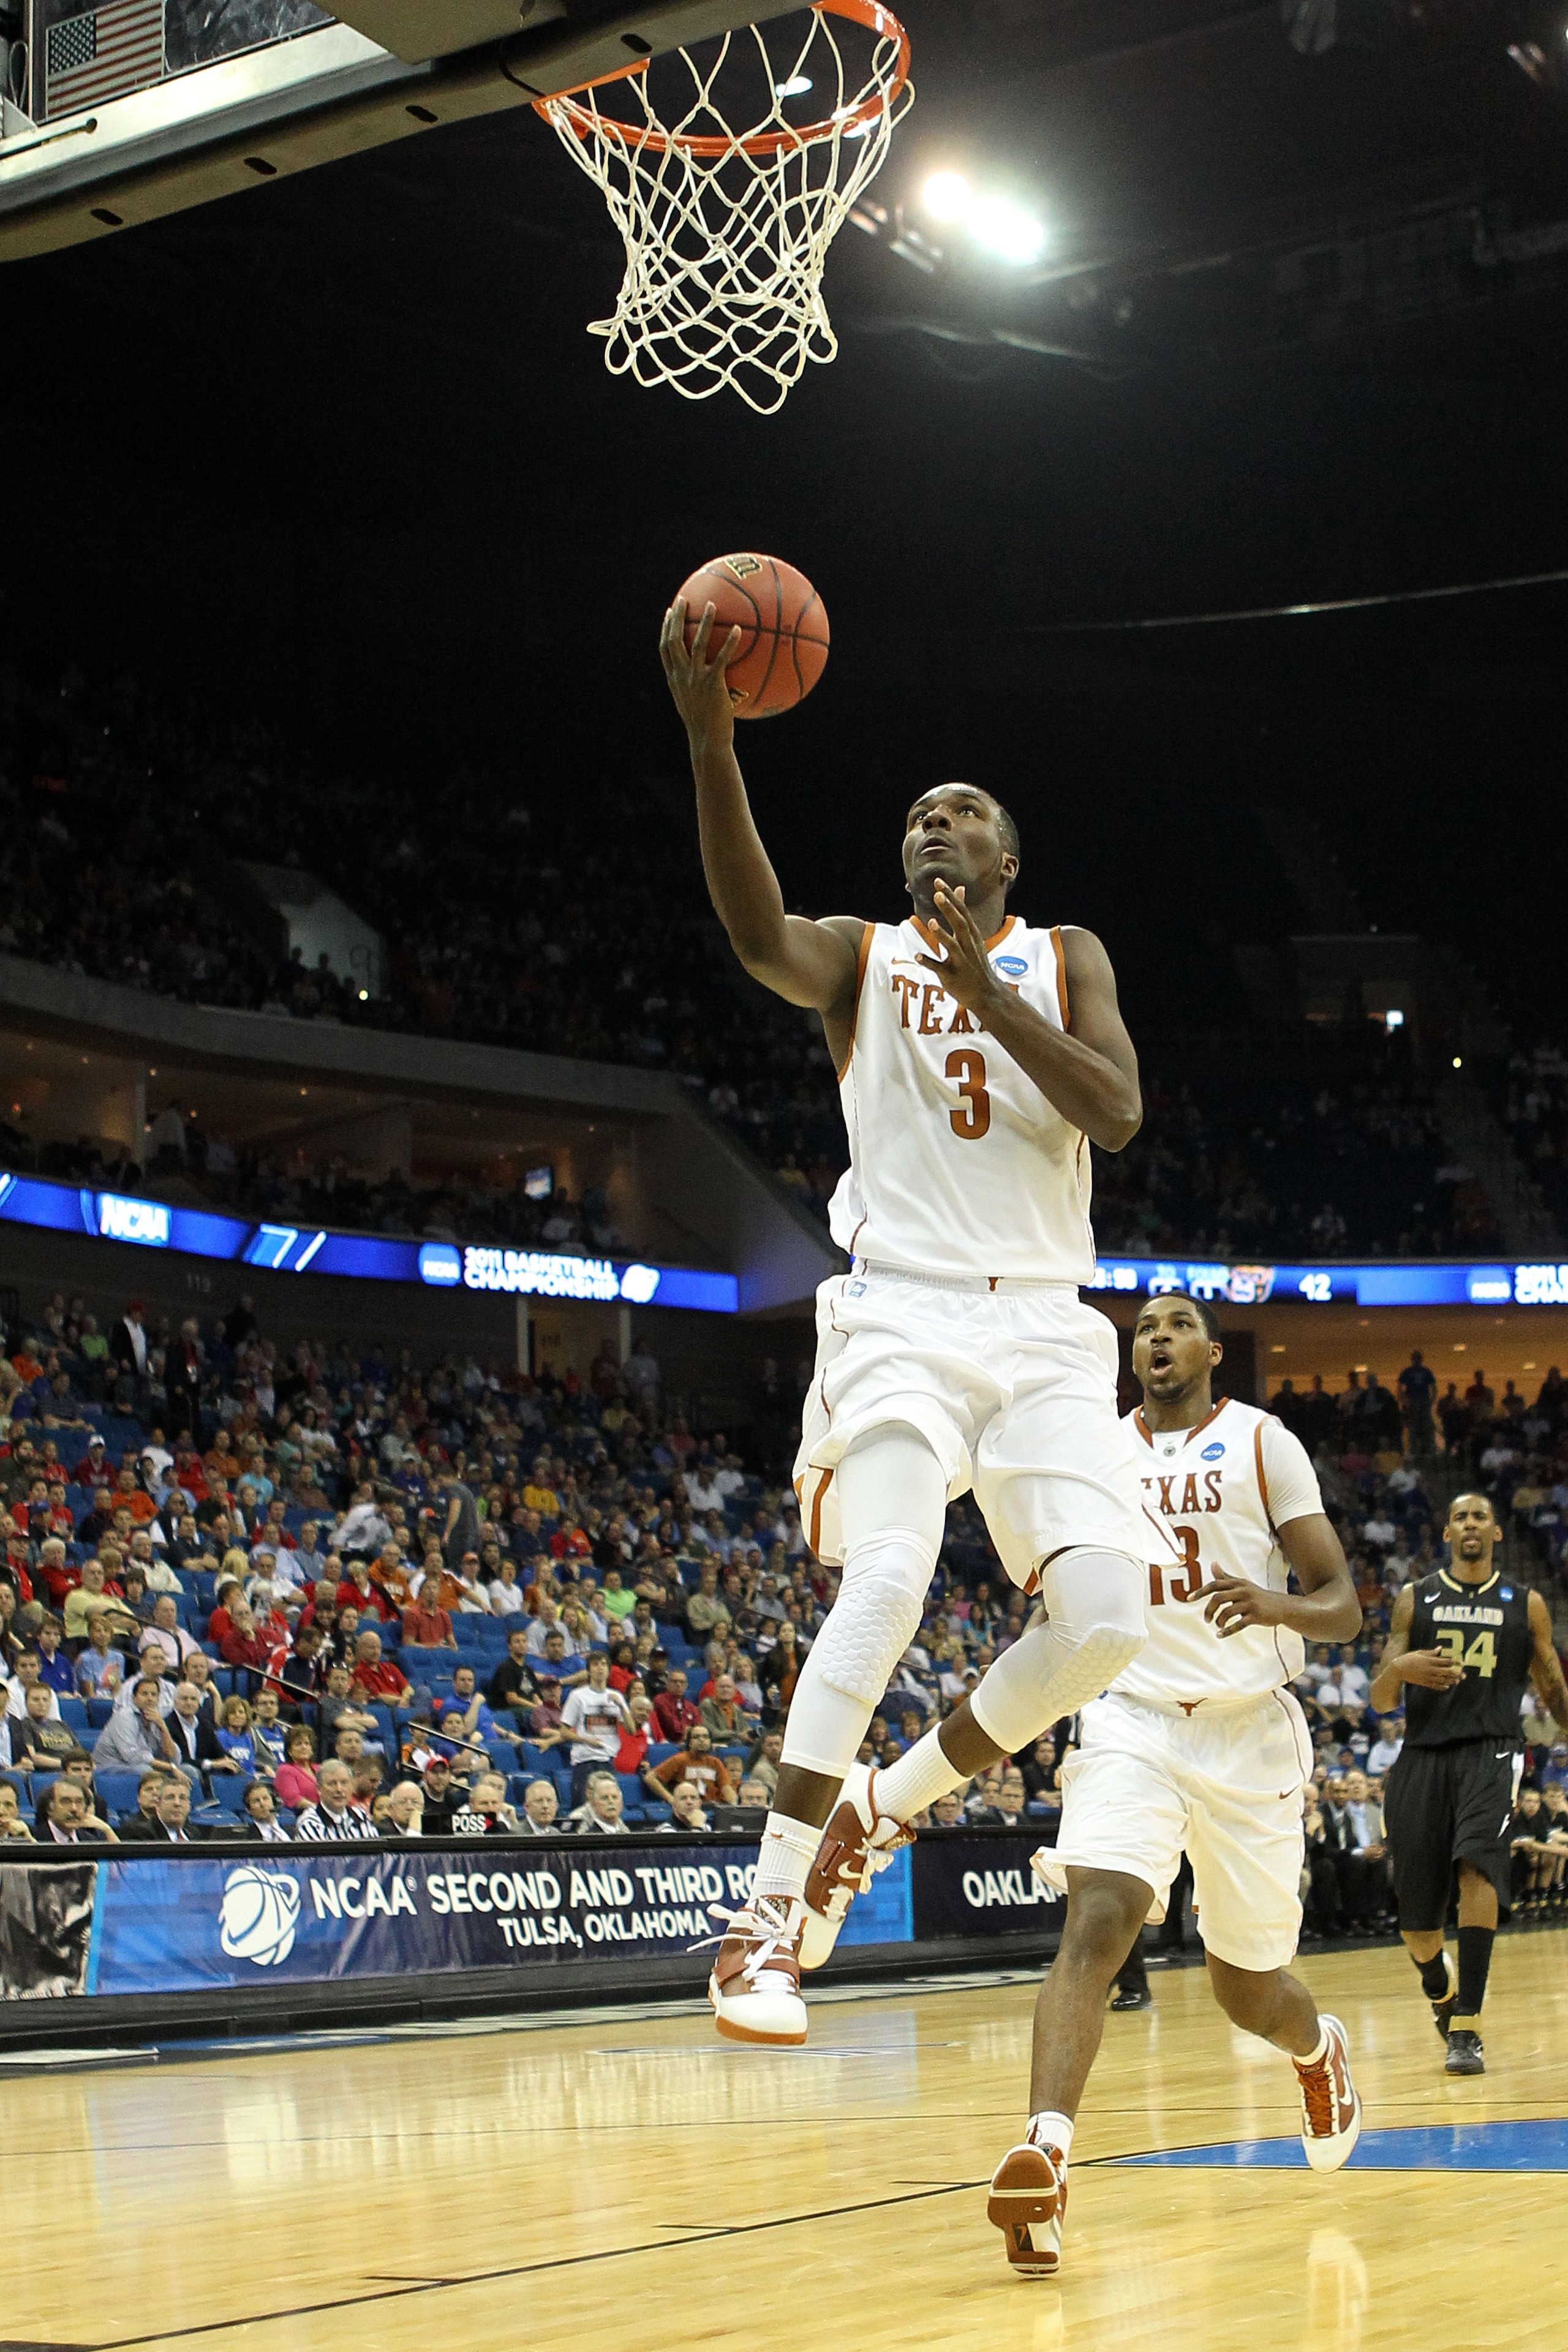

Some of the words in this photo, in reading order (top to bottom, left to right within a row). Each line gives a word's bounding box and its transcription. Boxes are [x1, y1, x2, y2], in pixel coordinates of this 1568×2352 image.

[1000, 962, 1025, 971] NCAA
[892, 974, 1019, 1034] TEX
[944, 1048, 991, 1140] 3
[100, 1196, 167, 1242] NCAA
[464, 1246, 503, 1270] 2011
[504, 1251, 615, 1281] BASKETBALL
[464, 1266, 619, 1300] CHAMPIONSHIP
[1299, 1272, 1331, 1300] 42
[1140, 1470, 1223, 1514] XAS
[1149, 1525, 1203, 1606] 13
[1433, 1605, 1504, 1626] OAKLAND
[1436, 1629, 1498, 1678] 34
[451, 1814, 487, 1832] POSS
[426, 1872, 562, 1915] SECOND
[570, 1868, 635, 1909] AND
[635, 1865, 724, 1904] THIRD
[962, 1870, 1063, 1908] OAKLA
[497, 1915, 584, 1949] TULSA,
[584, 1909, 712, 1942] OKLAHOMA
